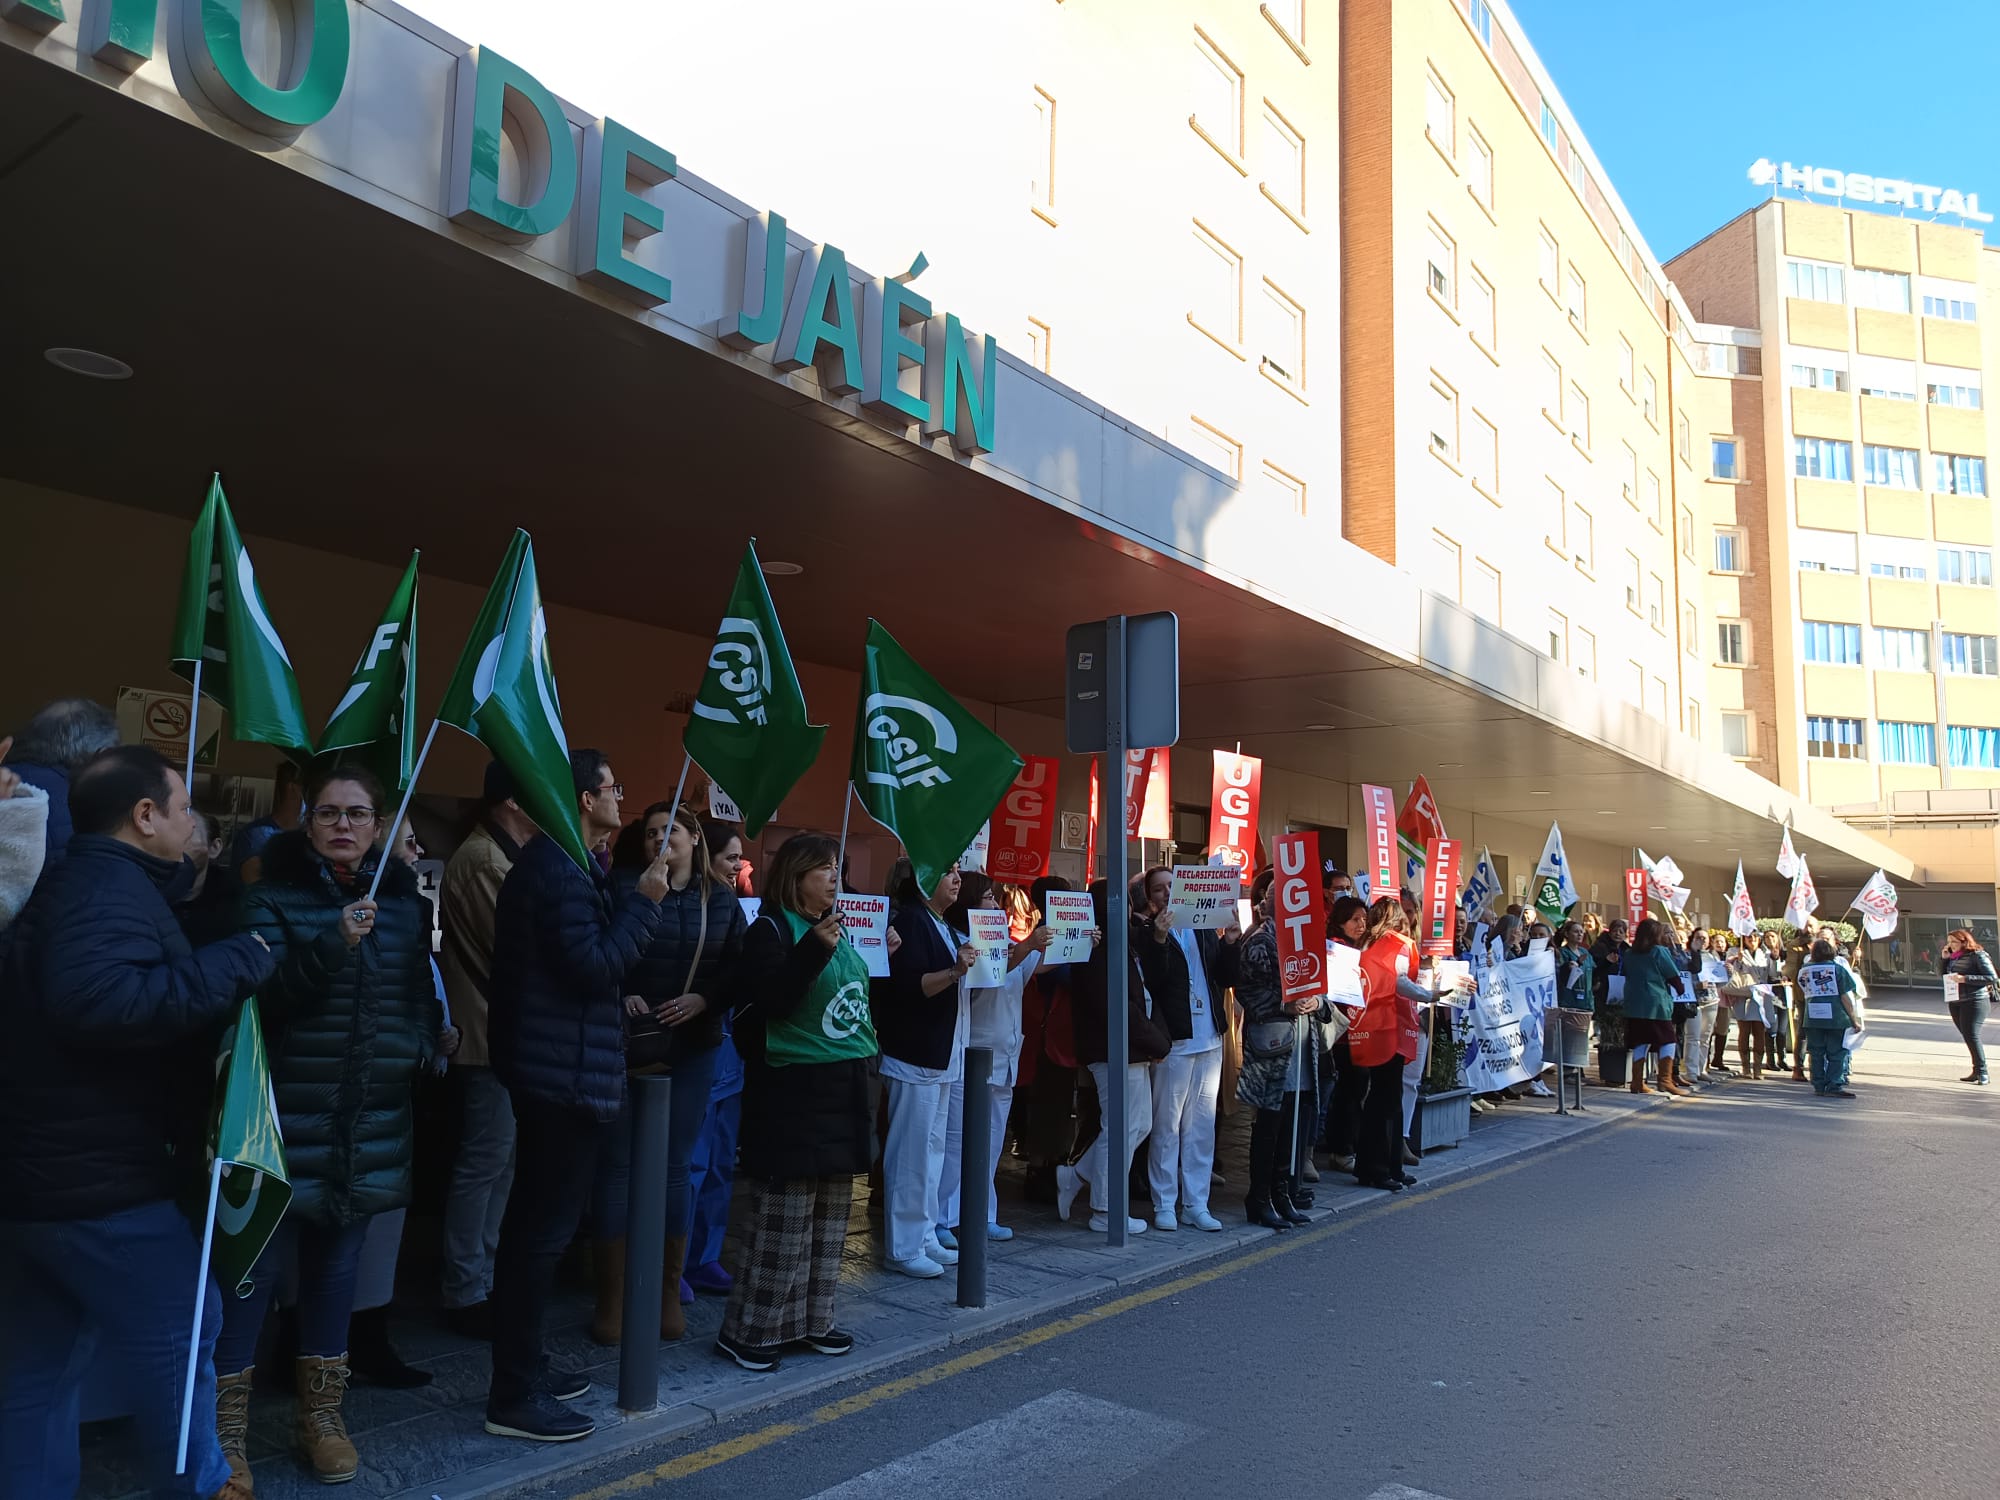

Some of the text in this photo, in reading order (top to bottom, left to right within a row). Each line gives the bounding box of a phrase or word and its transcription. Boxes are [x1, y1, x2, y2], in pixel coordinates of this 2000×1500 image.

[1781, 161, 1994, 223] HOSPITAL
[467, 44, 678, 306] DE
[738, 210, 997, 455] JAÉN
[707, 642, 768, 727] CSIF
[867, 715, 952, 788] CSIF
[1005, 763, 1046, 848] UGT
[1221, 761, 1252, 846] UGT
[1372, 789, 1390, 867] CCOO
[1050, 896, 1092, 908] RECLASIFICACIÓN
[1176, 868, 1239, 880] RECLASIFICACIÓN
[1184, 883, 1231, 893] PROFESIONAL
[1196, 898, 1216, 910] ¡YA!
[1279, 841, 1311, 952] UGT
[1432, 842, 1451, 918] CCOO
[1543, 885, 1560, 907] CSIF
[1628, 873, 1644, 922] UGT
[1056, 911, 1089, 921] PROFESIONAL
[1065, 928, 1080, 941] ¡YA!
